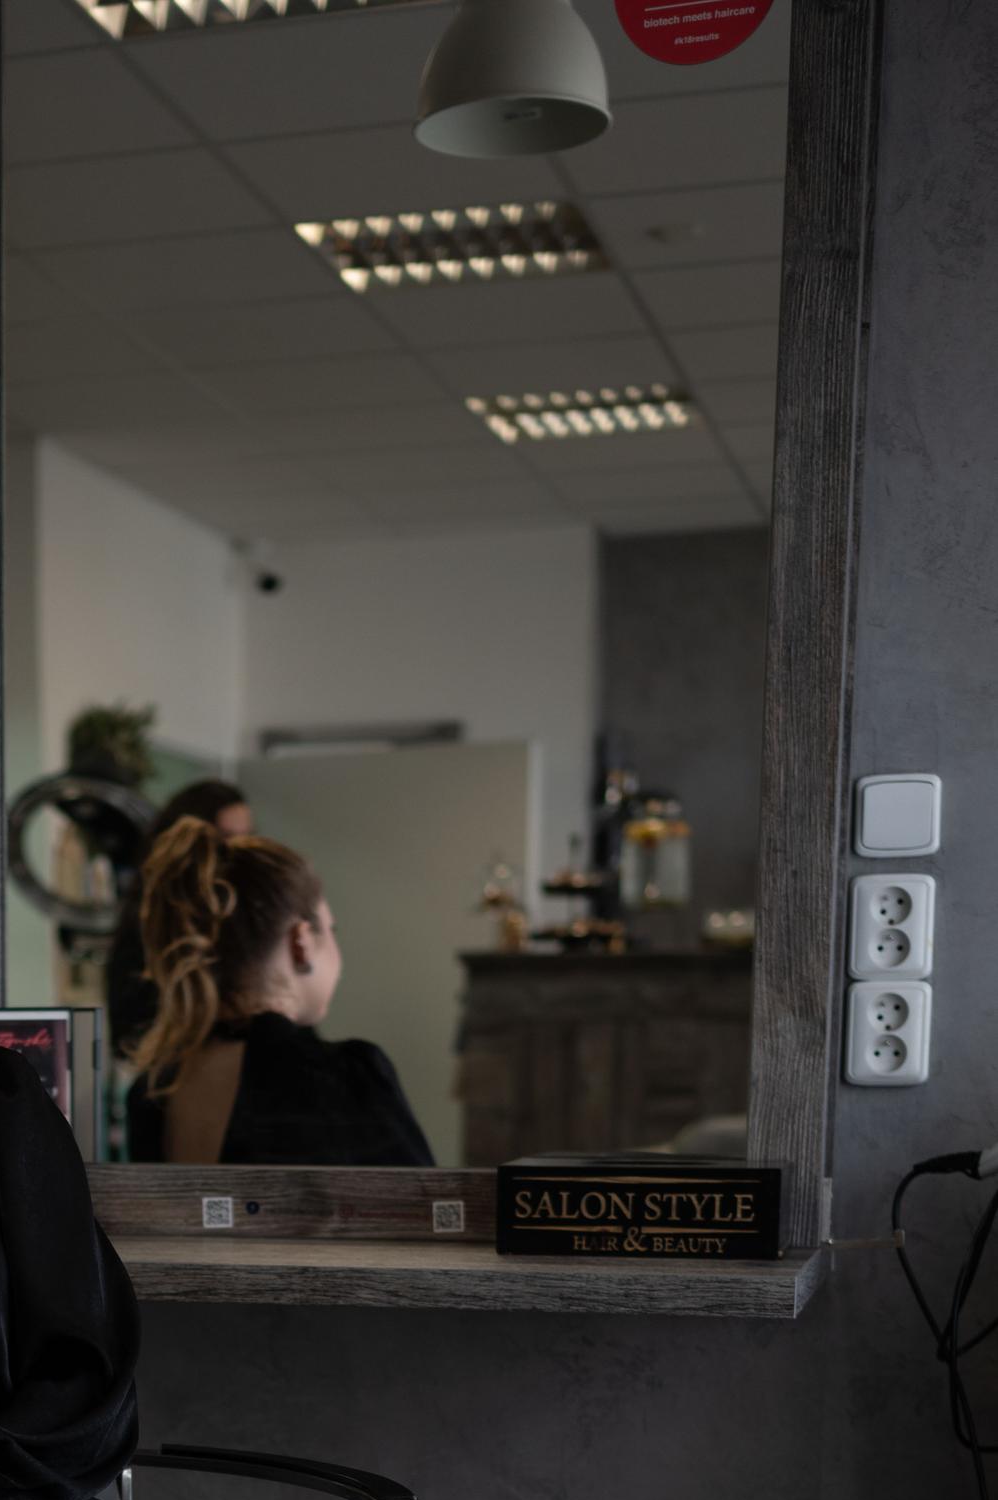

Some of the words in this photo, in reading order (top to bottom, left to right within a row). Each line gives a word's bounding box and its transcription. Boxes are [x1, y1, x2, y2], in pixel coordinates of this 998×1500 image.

[643, 15, 680, 28] biotech
[682, 11, 712, 23] meets
[714, 6, 755, 19] haircare
[514, 1190, 634, 1219] SALON
[644, 1193, 755, 1222] STYLE
[622, 1226, 647, 1251] &
[653, 1238, 727, 1253] BEAUTY
